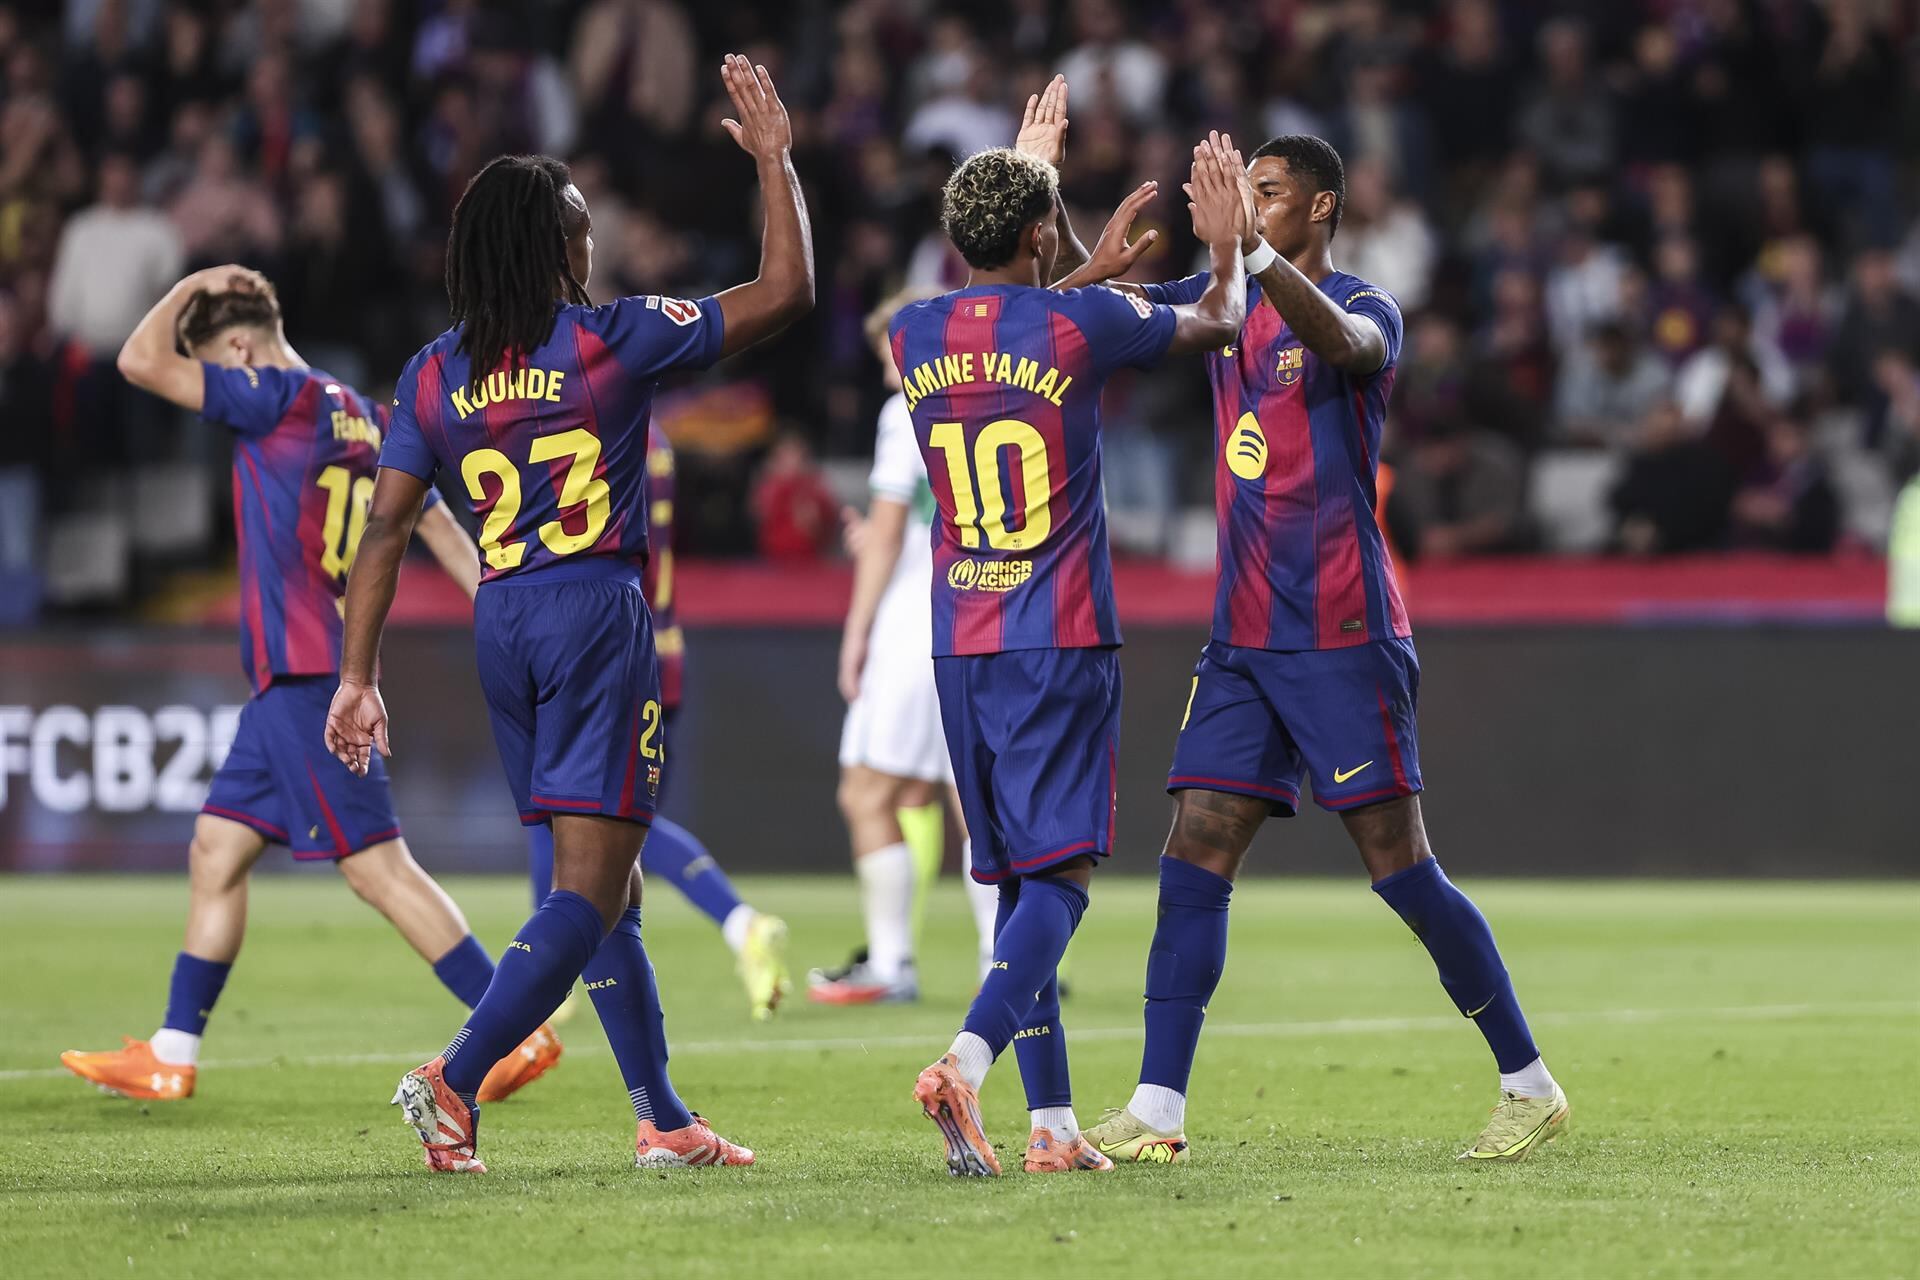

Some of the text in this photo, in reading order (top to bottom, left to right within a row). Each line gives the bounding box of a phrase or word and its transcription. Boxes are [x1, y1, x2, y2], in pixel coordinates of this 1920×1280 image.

[451, 368, 565, 420] KOUNDE
[982, 353, 1072, 407] YAMAL
[461, 428, 611, 570] 23
[929, 419, 1051, 550] 10
[981, 560, 1033, 573] UNHCR
[640, 699, 665, 764] 2
